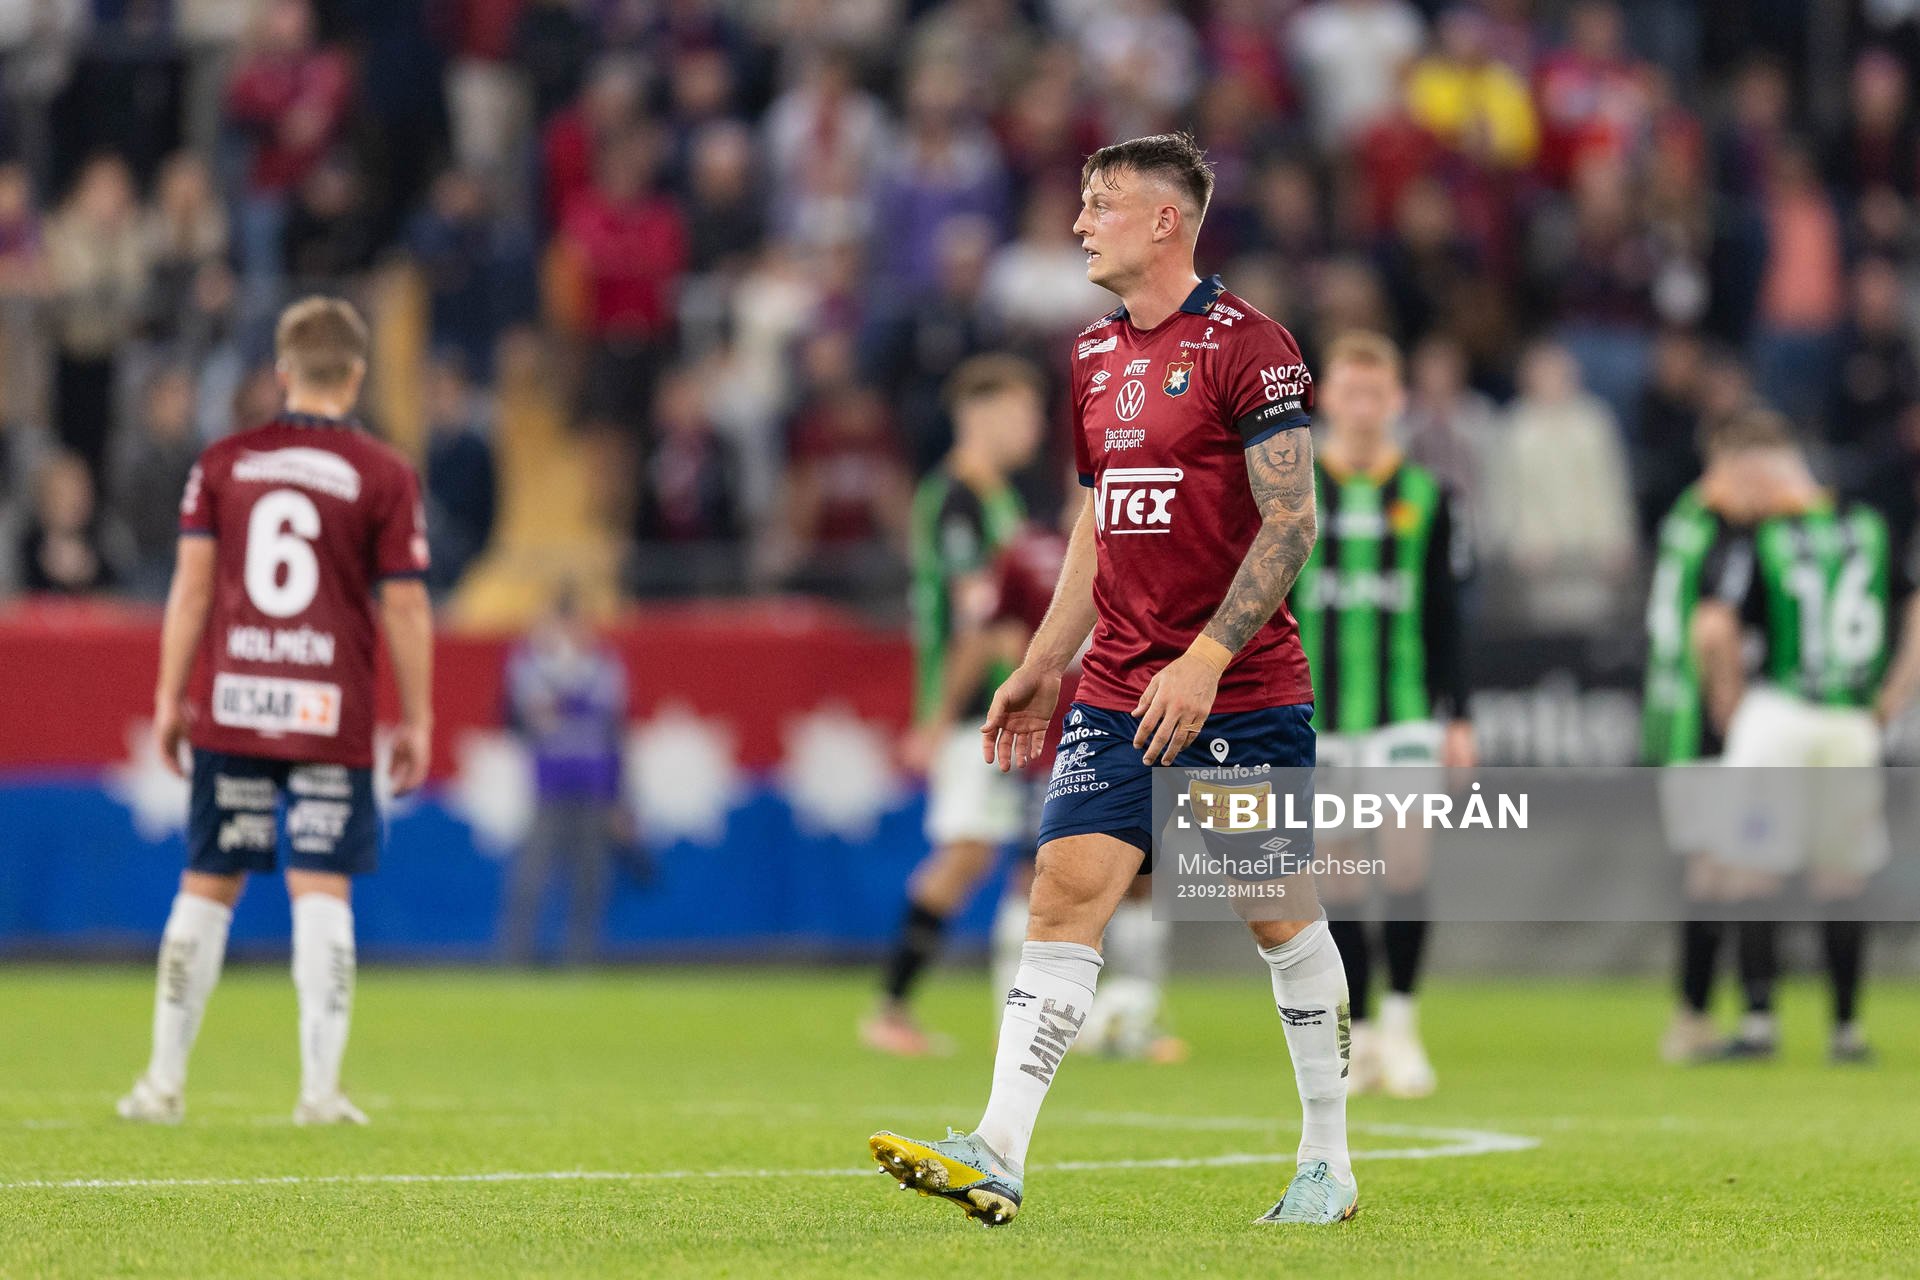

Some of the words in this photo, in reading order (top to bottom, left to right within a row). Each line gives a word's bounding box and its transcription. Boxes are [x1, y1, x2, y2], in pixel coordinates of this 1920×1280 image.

[1104, 428, 1146, 442] factoring
[1263, 404, 1285, 419] FREE
[1103, 440, 1143, 453] gruppen.
[244, 488, 321, 618] 6
[1783, 553, 1885, 674] 16
[1019, 998, 1087, 1087] MIKE
